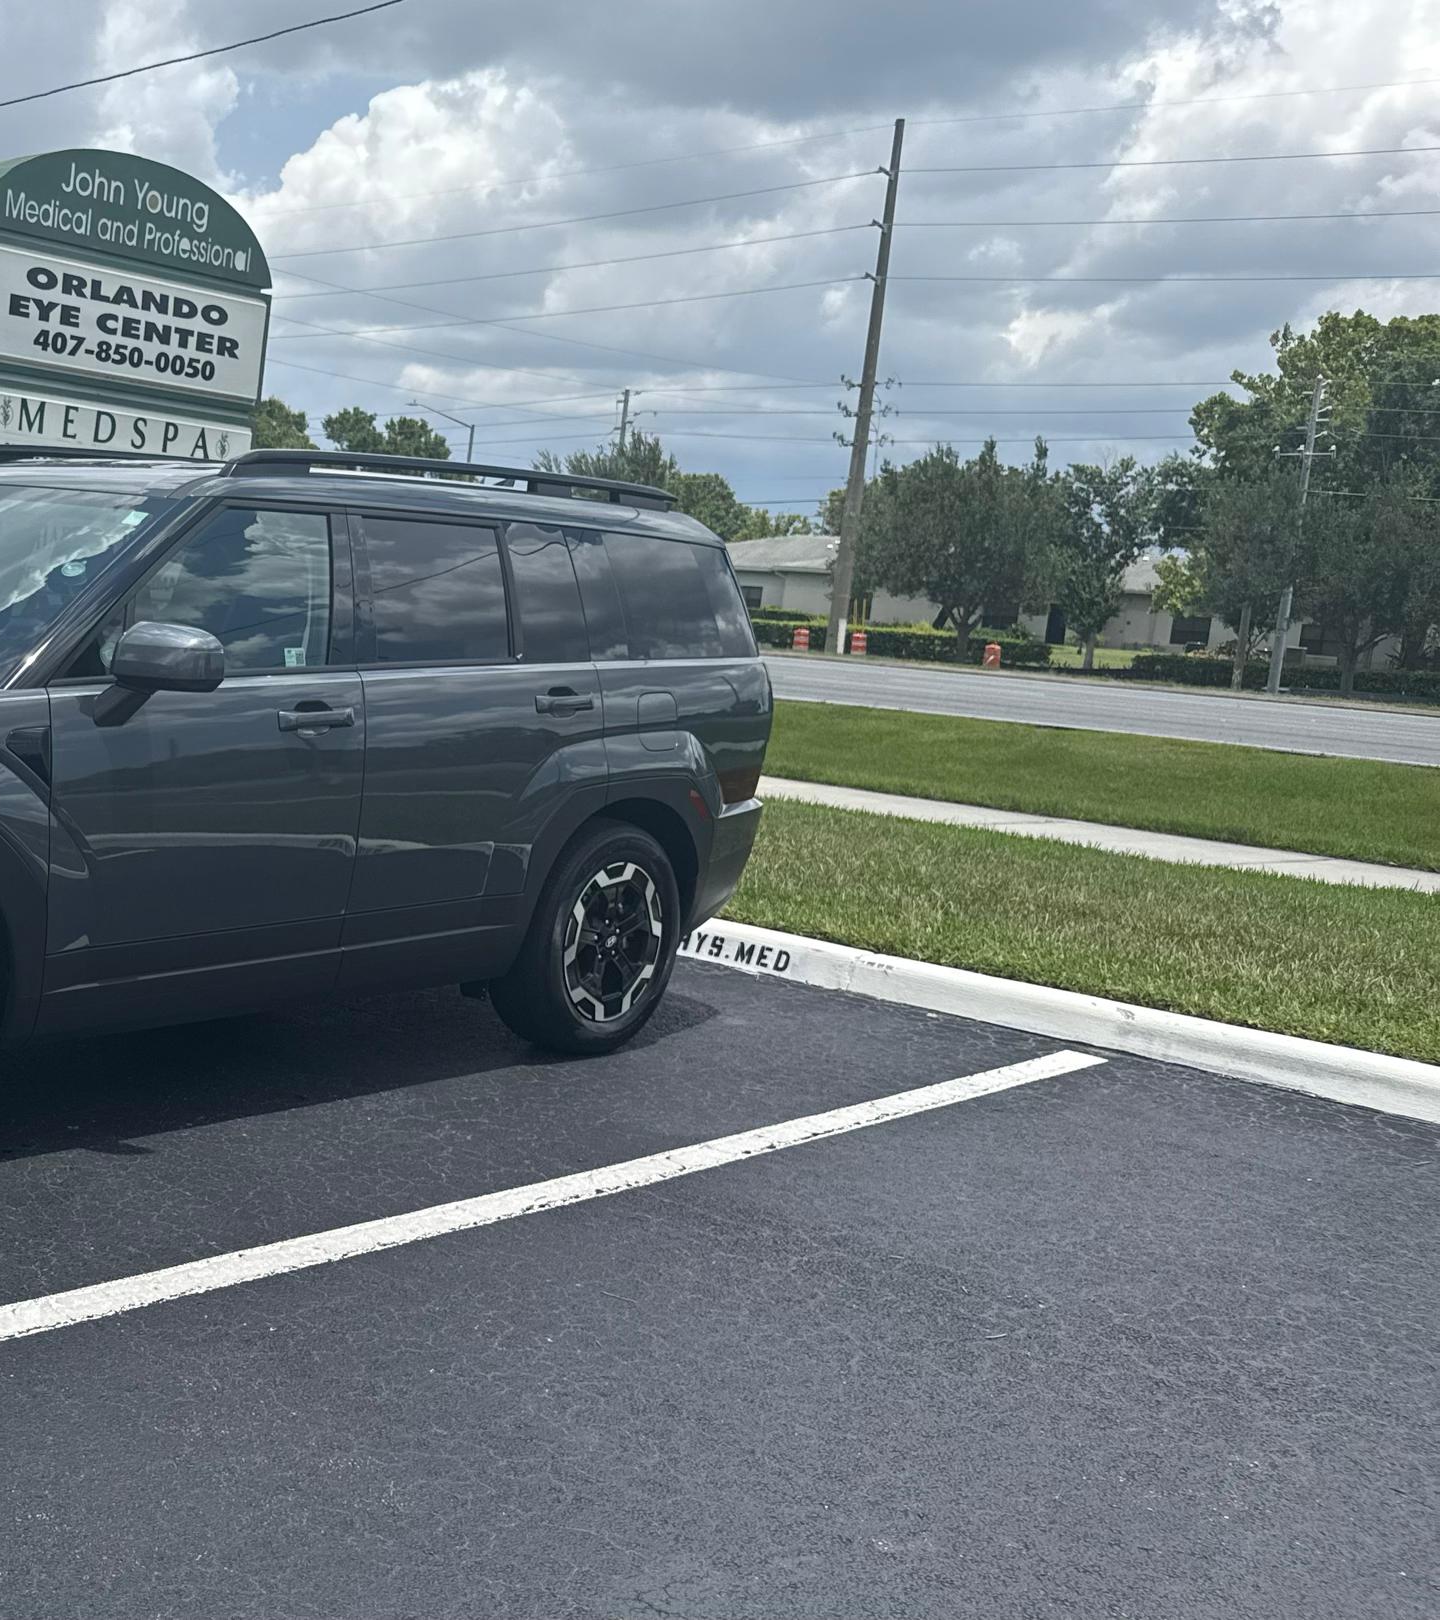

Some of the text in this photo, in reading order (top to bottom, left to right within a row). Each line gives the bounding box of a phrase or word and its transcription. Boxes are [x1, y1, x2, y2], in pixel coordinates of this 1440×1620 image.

[5, 188, 251, 273] Medical and Professional
[61, 162, 209, 233] John Young
[9, 293, 240, 359] EYE CENTER
[26, 267, 229, 326] ORLANDO
[33, 329, 216, 381] 407-850-0050
